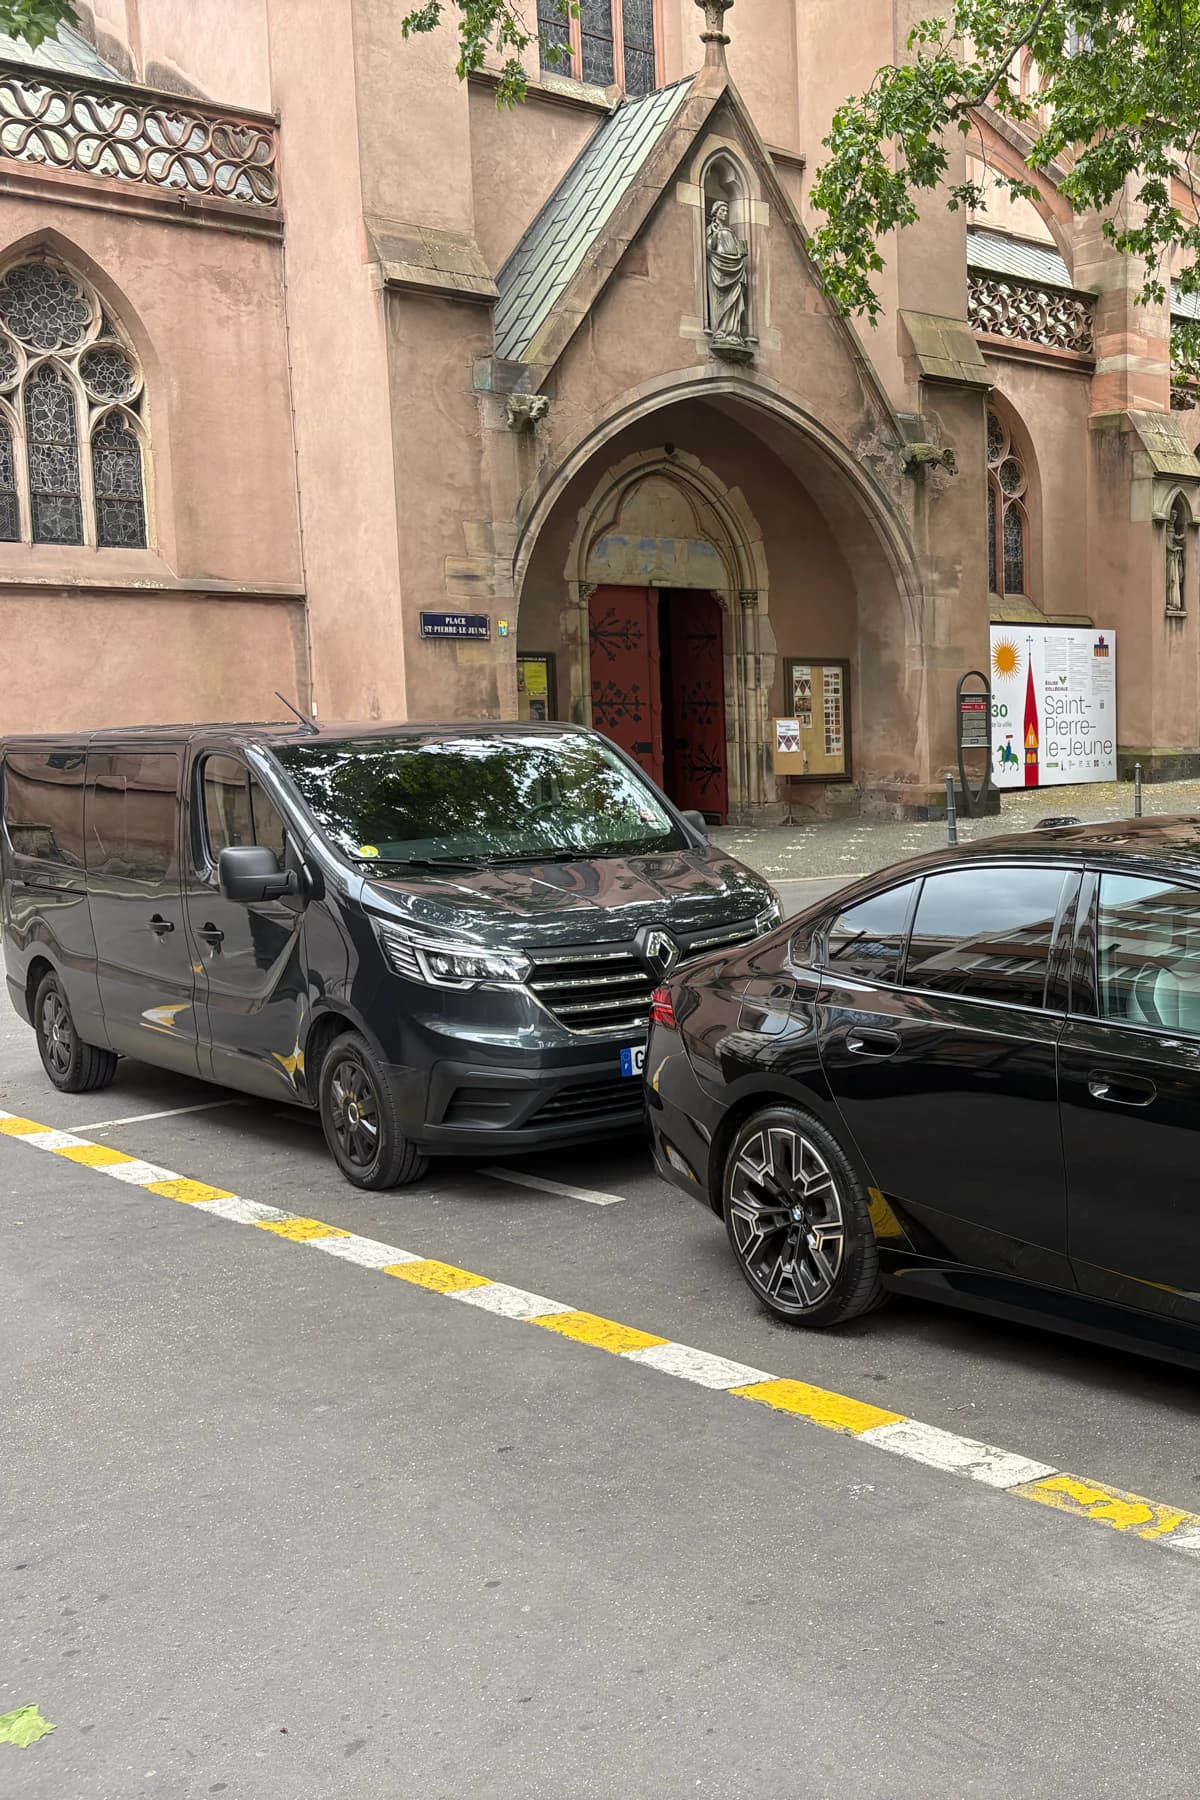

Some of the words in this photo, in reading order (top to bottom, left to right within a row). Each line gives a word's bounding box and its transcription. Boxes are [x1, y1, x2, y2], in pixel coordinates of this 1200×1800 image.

[445, 617, 466, 625] PLACE
[1044, 695, 1092, 715] Saint-
[1045, 716, 1096, 736] Pierre-
[1046, 737, 1113, 757] le-Jeune
[635, 1050, 645, 1070] G
